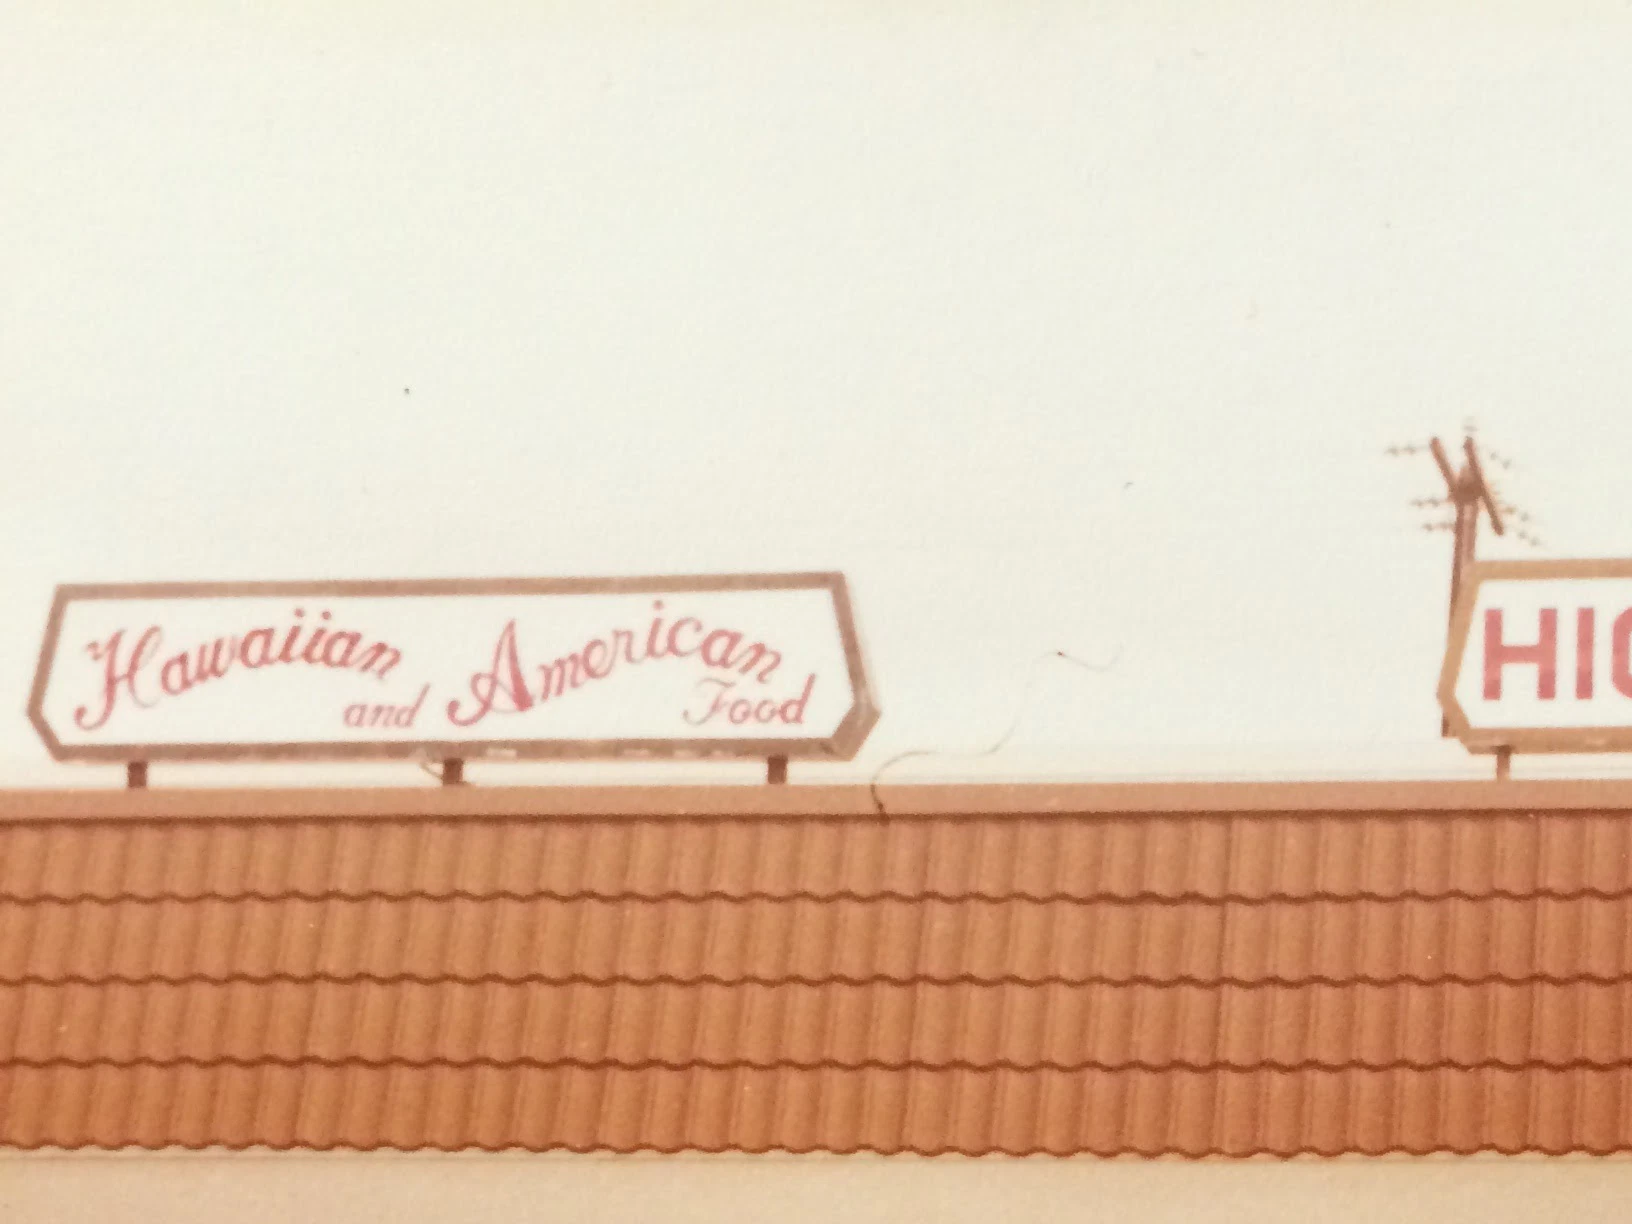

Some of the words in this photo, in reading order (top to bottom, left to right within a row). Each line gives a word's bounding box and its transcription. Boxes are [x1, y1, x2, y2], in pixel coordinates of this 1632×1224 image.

[74, 606, 404, 731] Hawaiian
[342, 683, 428, 728] and
[446, 600, 784, 728] American
[682, 673, 816, 727] Food
